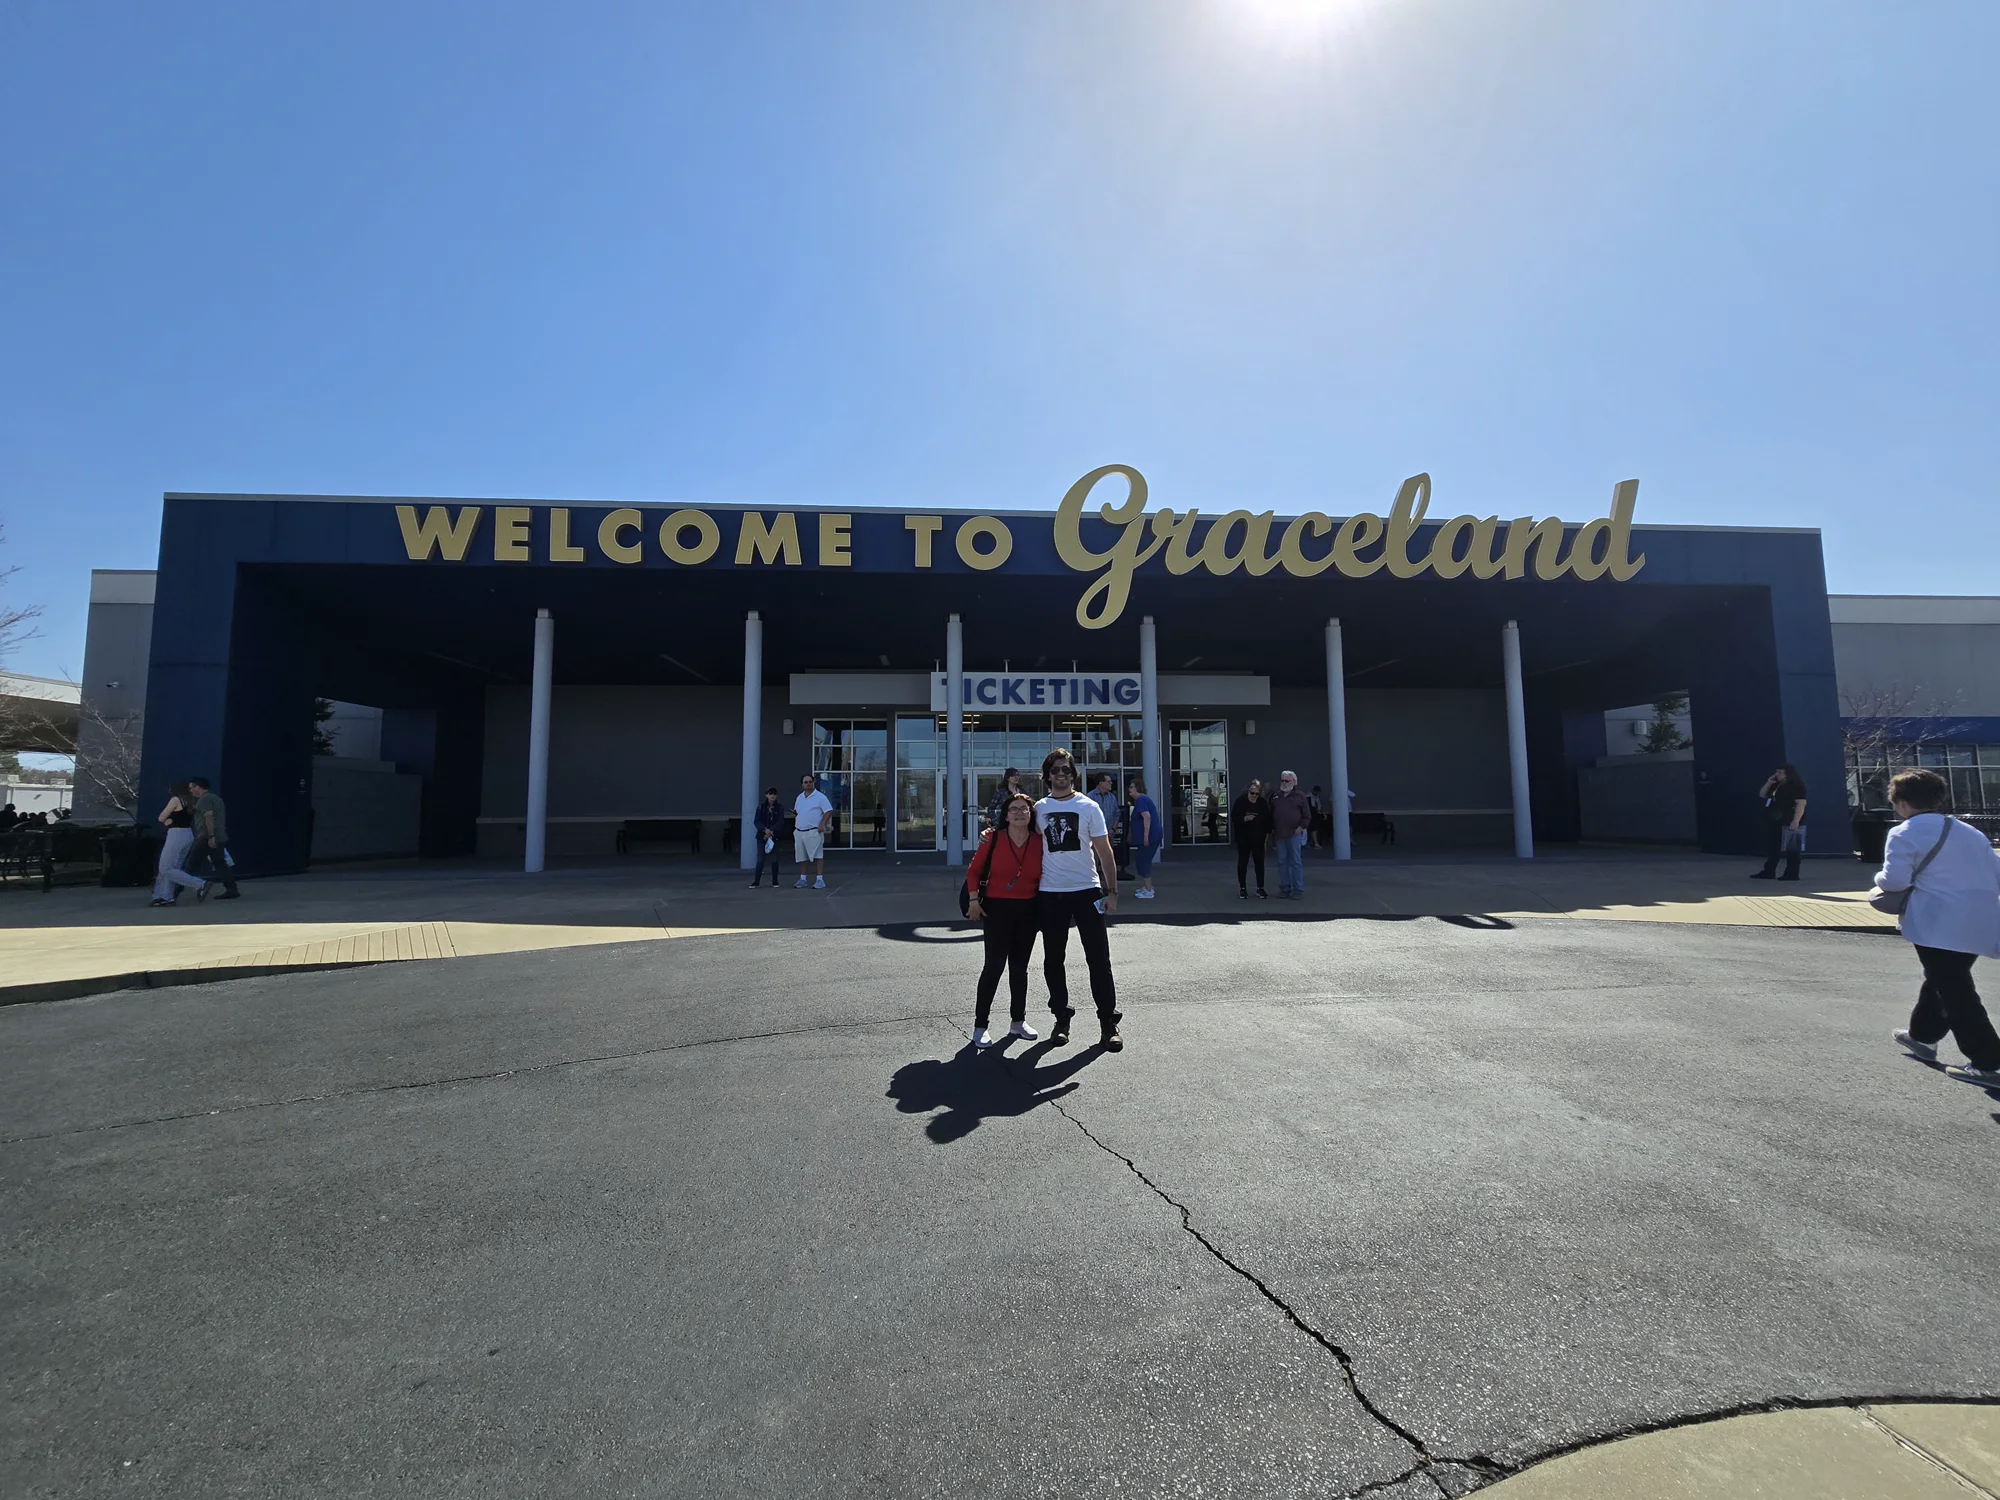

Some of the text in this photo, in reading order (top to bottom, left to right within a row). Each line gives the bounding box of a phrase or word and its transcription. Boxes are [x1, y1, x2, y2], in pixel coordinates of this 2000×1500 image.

[395, 463, 1646, 630] WELCOME TO Graceland
